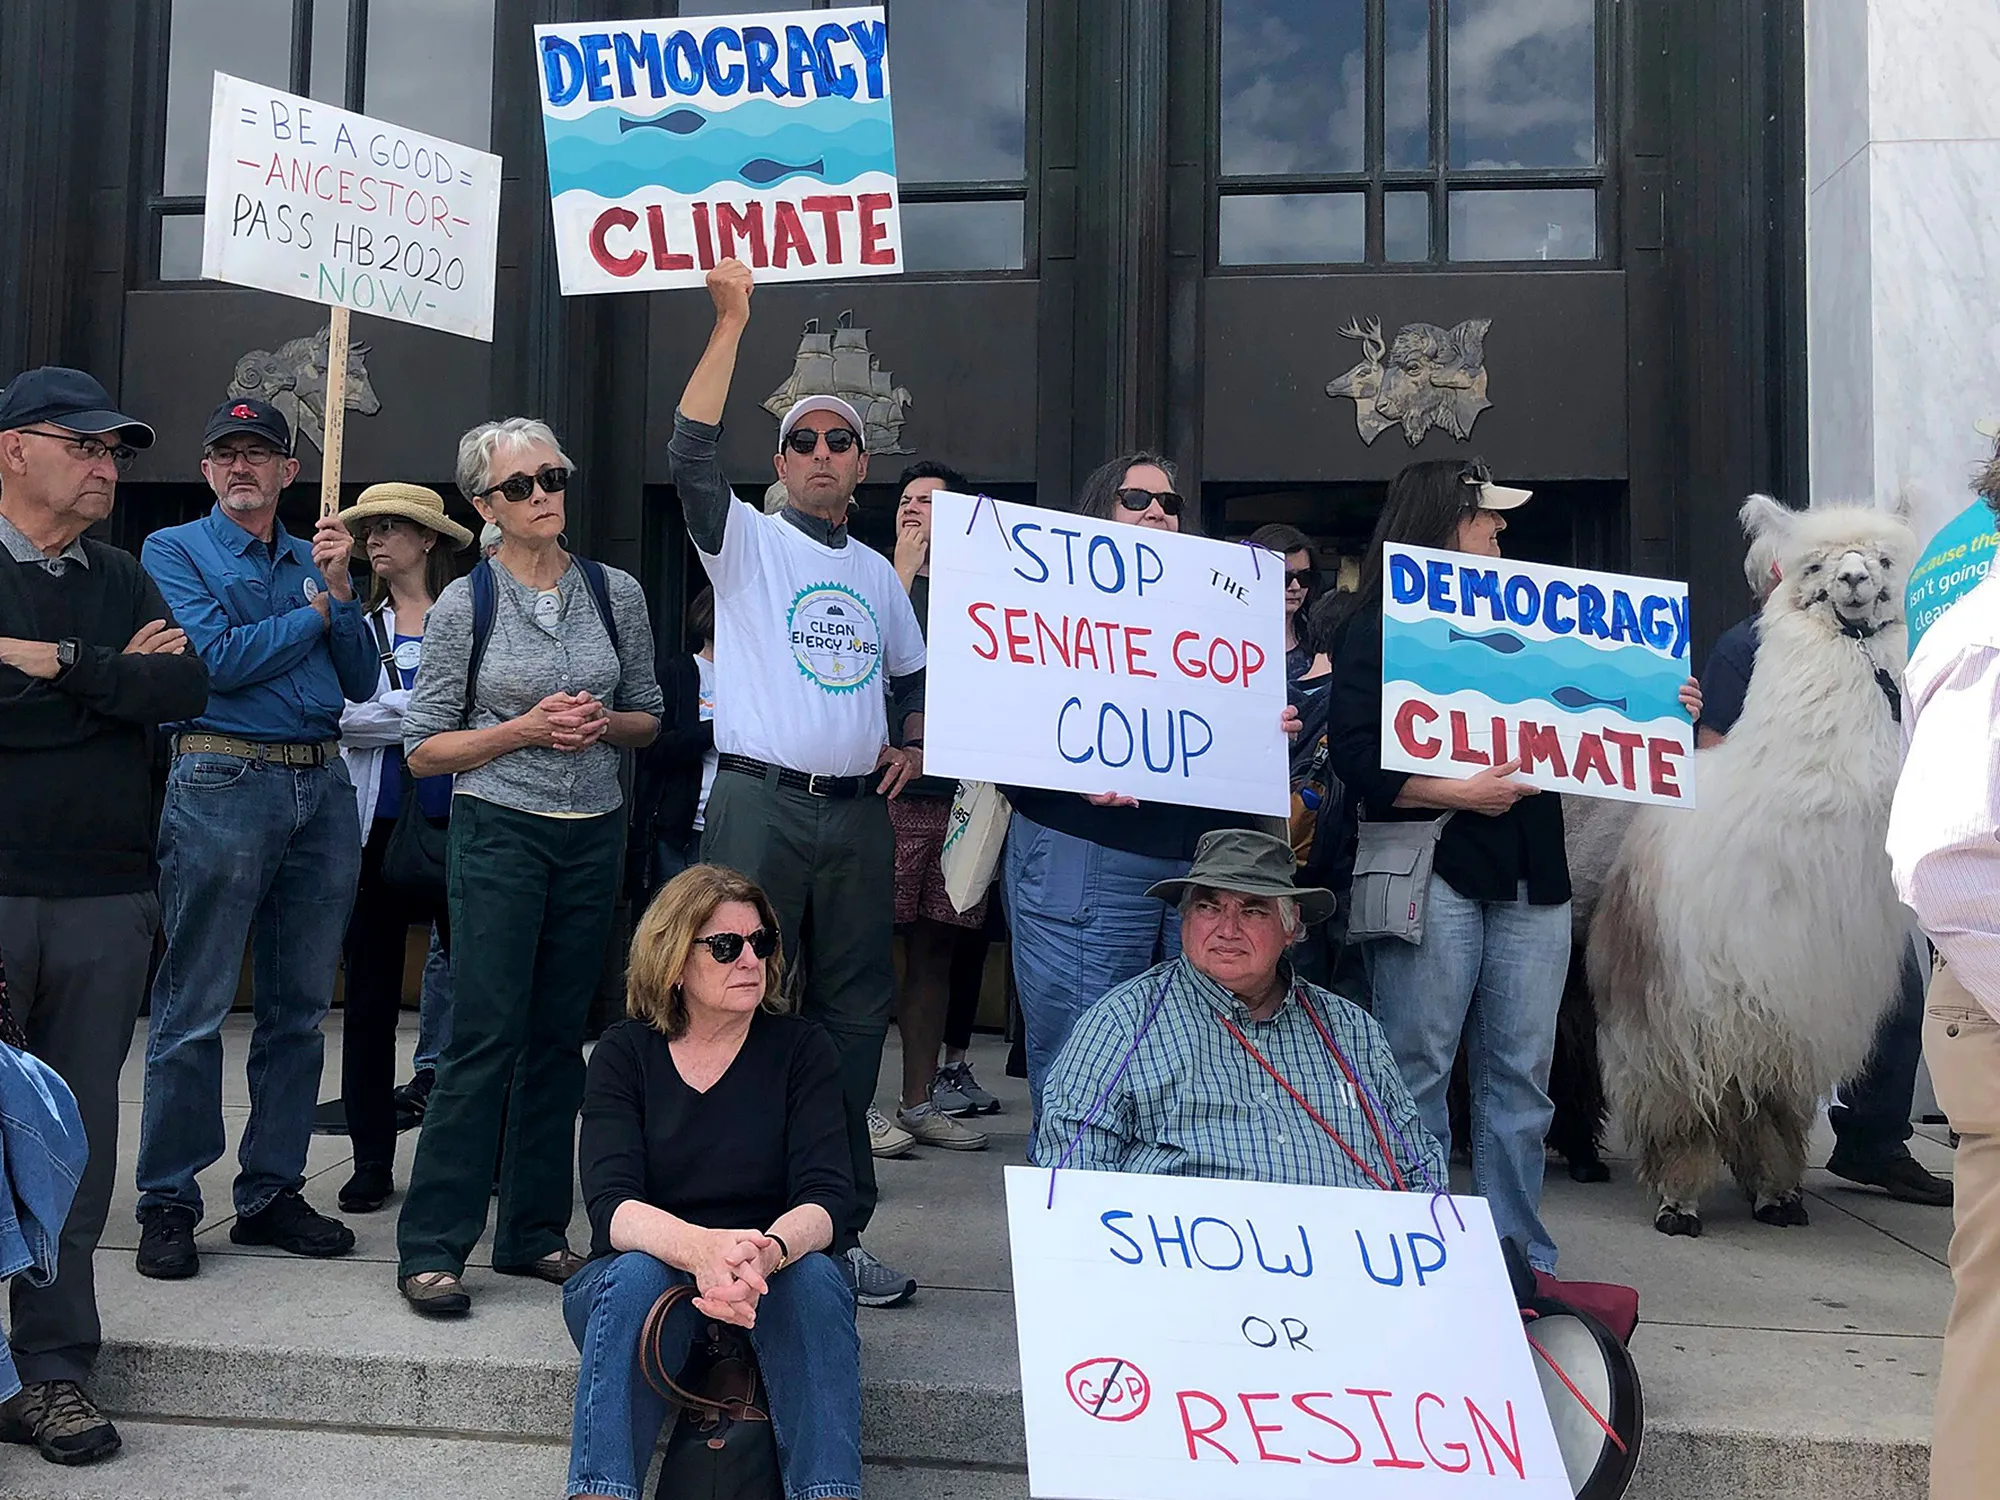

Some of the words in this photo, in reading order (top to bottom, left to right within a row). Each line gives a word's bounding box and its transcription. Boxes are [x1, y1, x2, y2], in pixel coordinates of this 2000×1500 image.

[539, 20, 885, 105] DEMOCRACY
[335, 123, 358, 158] A
[233, 194, 314, 250] PASS
[334, 223, 464, 291] HB2020
[589, 193, 895, 276] CLIMATE
[1012, 523, 1164, 597] STOP
[1209, 567, 1249, 606] THE
[1390, 553, 1690, 659] DEMOCRACY
[1939, 560, 1990, 596] going
[810, 621, 855, 636] CLEAN
[968, 602, 1158, 679] SENATE
[1173, 630, 1265, 688] GOP
[1058, 697, 1213, 778] COUP
[1394, 700, 1685, 797] CLIMATE
[1101, 1210, 1314, 1278] SHOW
[1355, 1230, 1447, 1287] UP
[1242, 1316, 1314, 1352] OR
[1077, 1374, 1145, 1409] GOP
[1177, 1389, 1526, 1480] RESIGN
